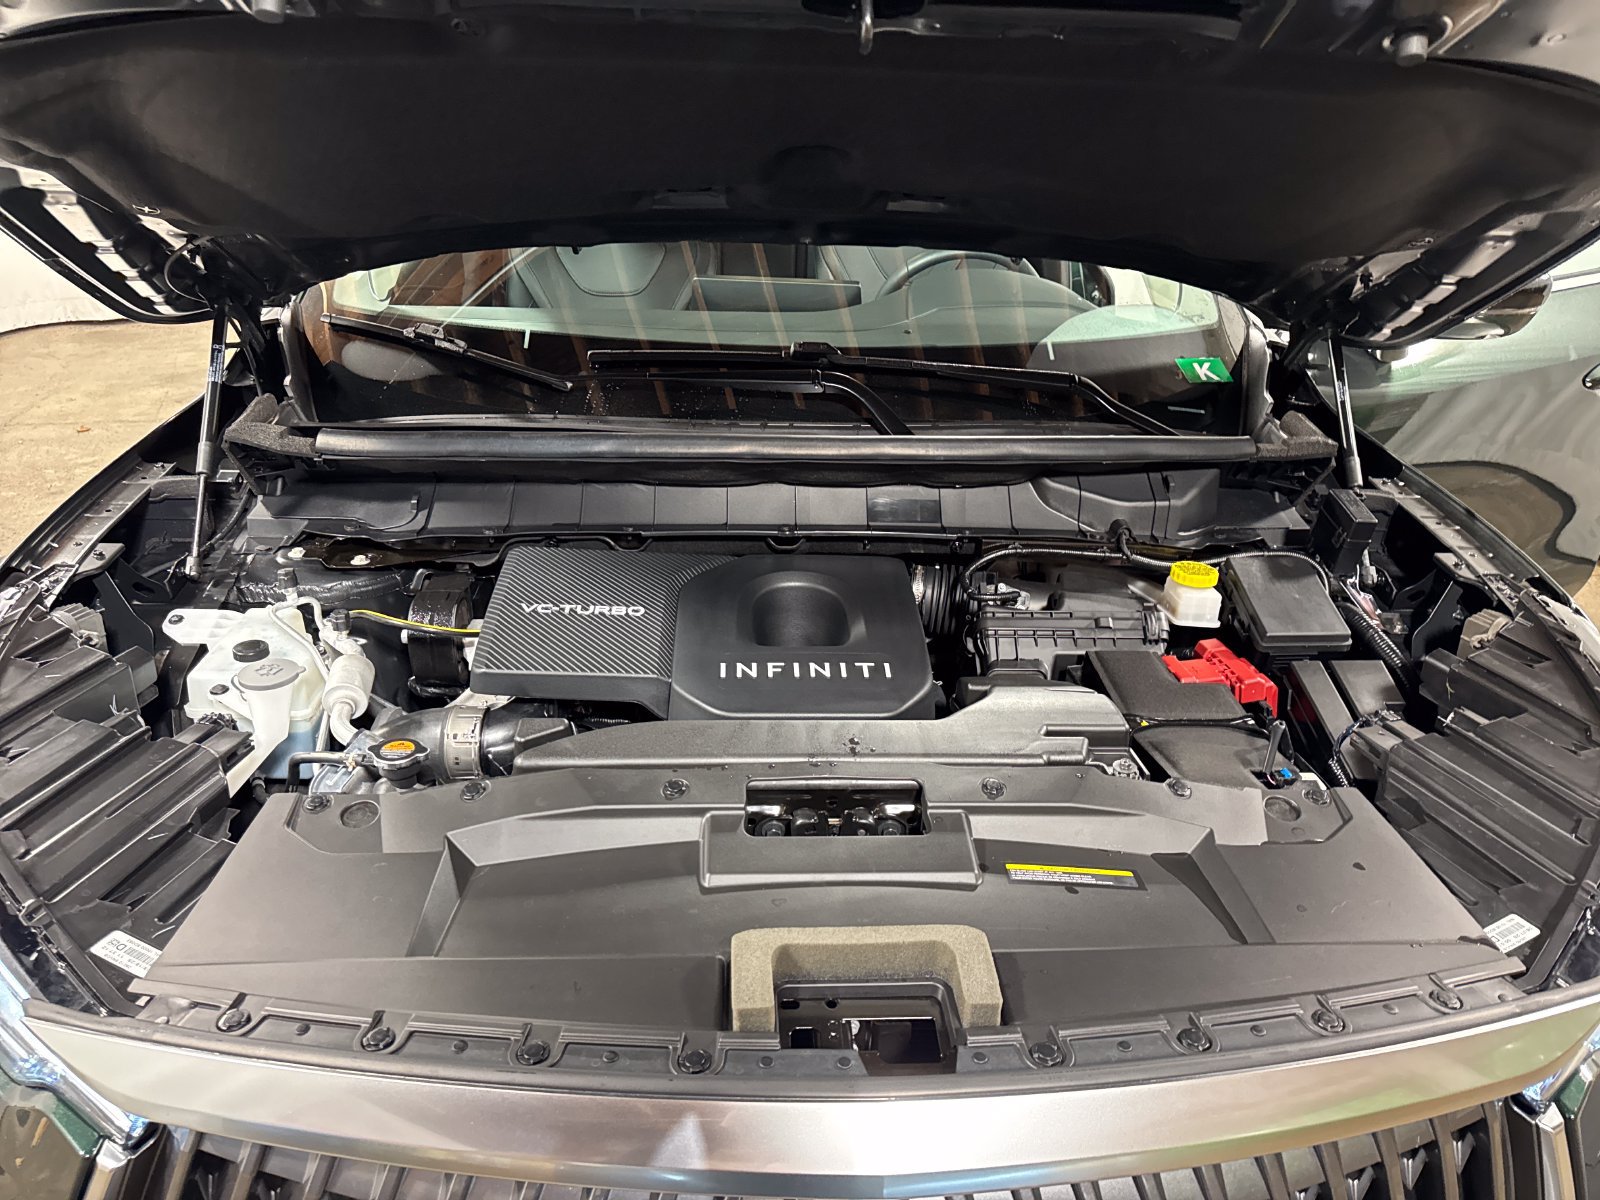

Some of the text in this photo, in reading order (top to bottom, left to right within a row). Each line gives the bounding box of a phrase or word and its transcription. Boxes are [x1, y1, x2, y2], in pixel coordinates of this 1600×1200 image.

[1192, 362, 1221, 381] K
[520, 602, 645, 617] VC-TURBO
[719, 662, 892, 679] INFINITI
